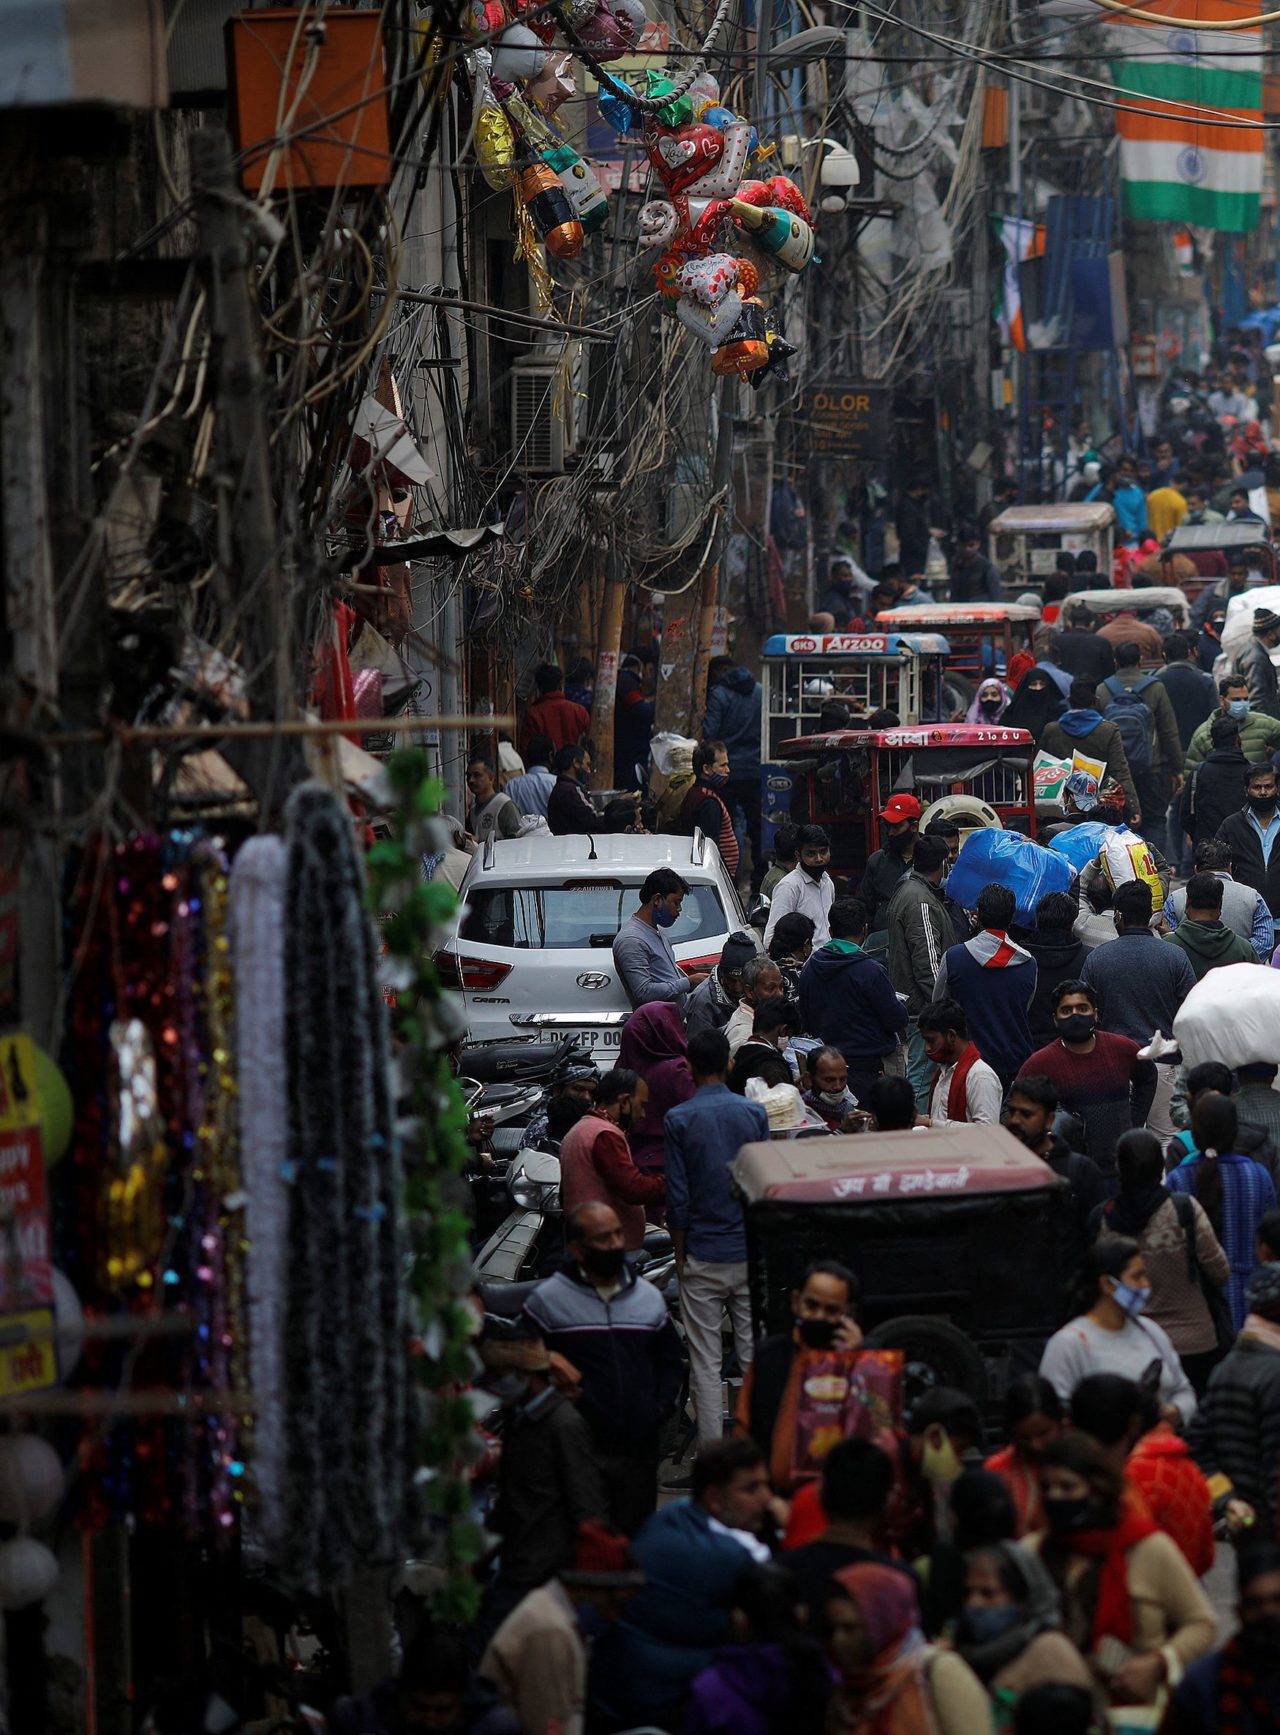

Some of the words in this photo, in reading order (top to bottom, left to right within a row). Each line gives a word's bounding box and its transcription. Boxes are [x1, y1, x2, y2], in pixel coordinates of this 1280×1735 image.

[814, 393, 870, 411] OLOR
[793, 640, 814, 651] SKS
[827, 637, 884, 650] Arzoo
[832, 1176, 866, 1197] जय
